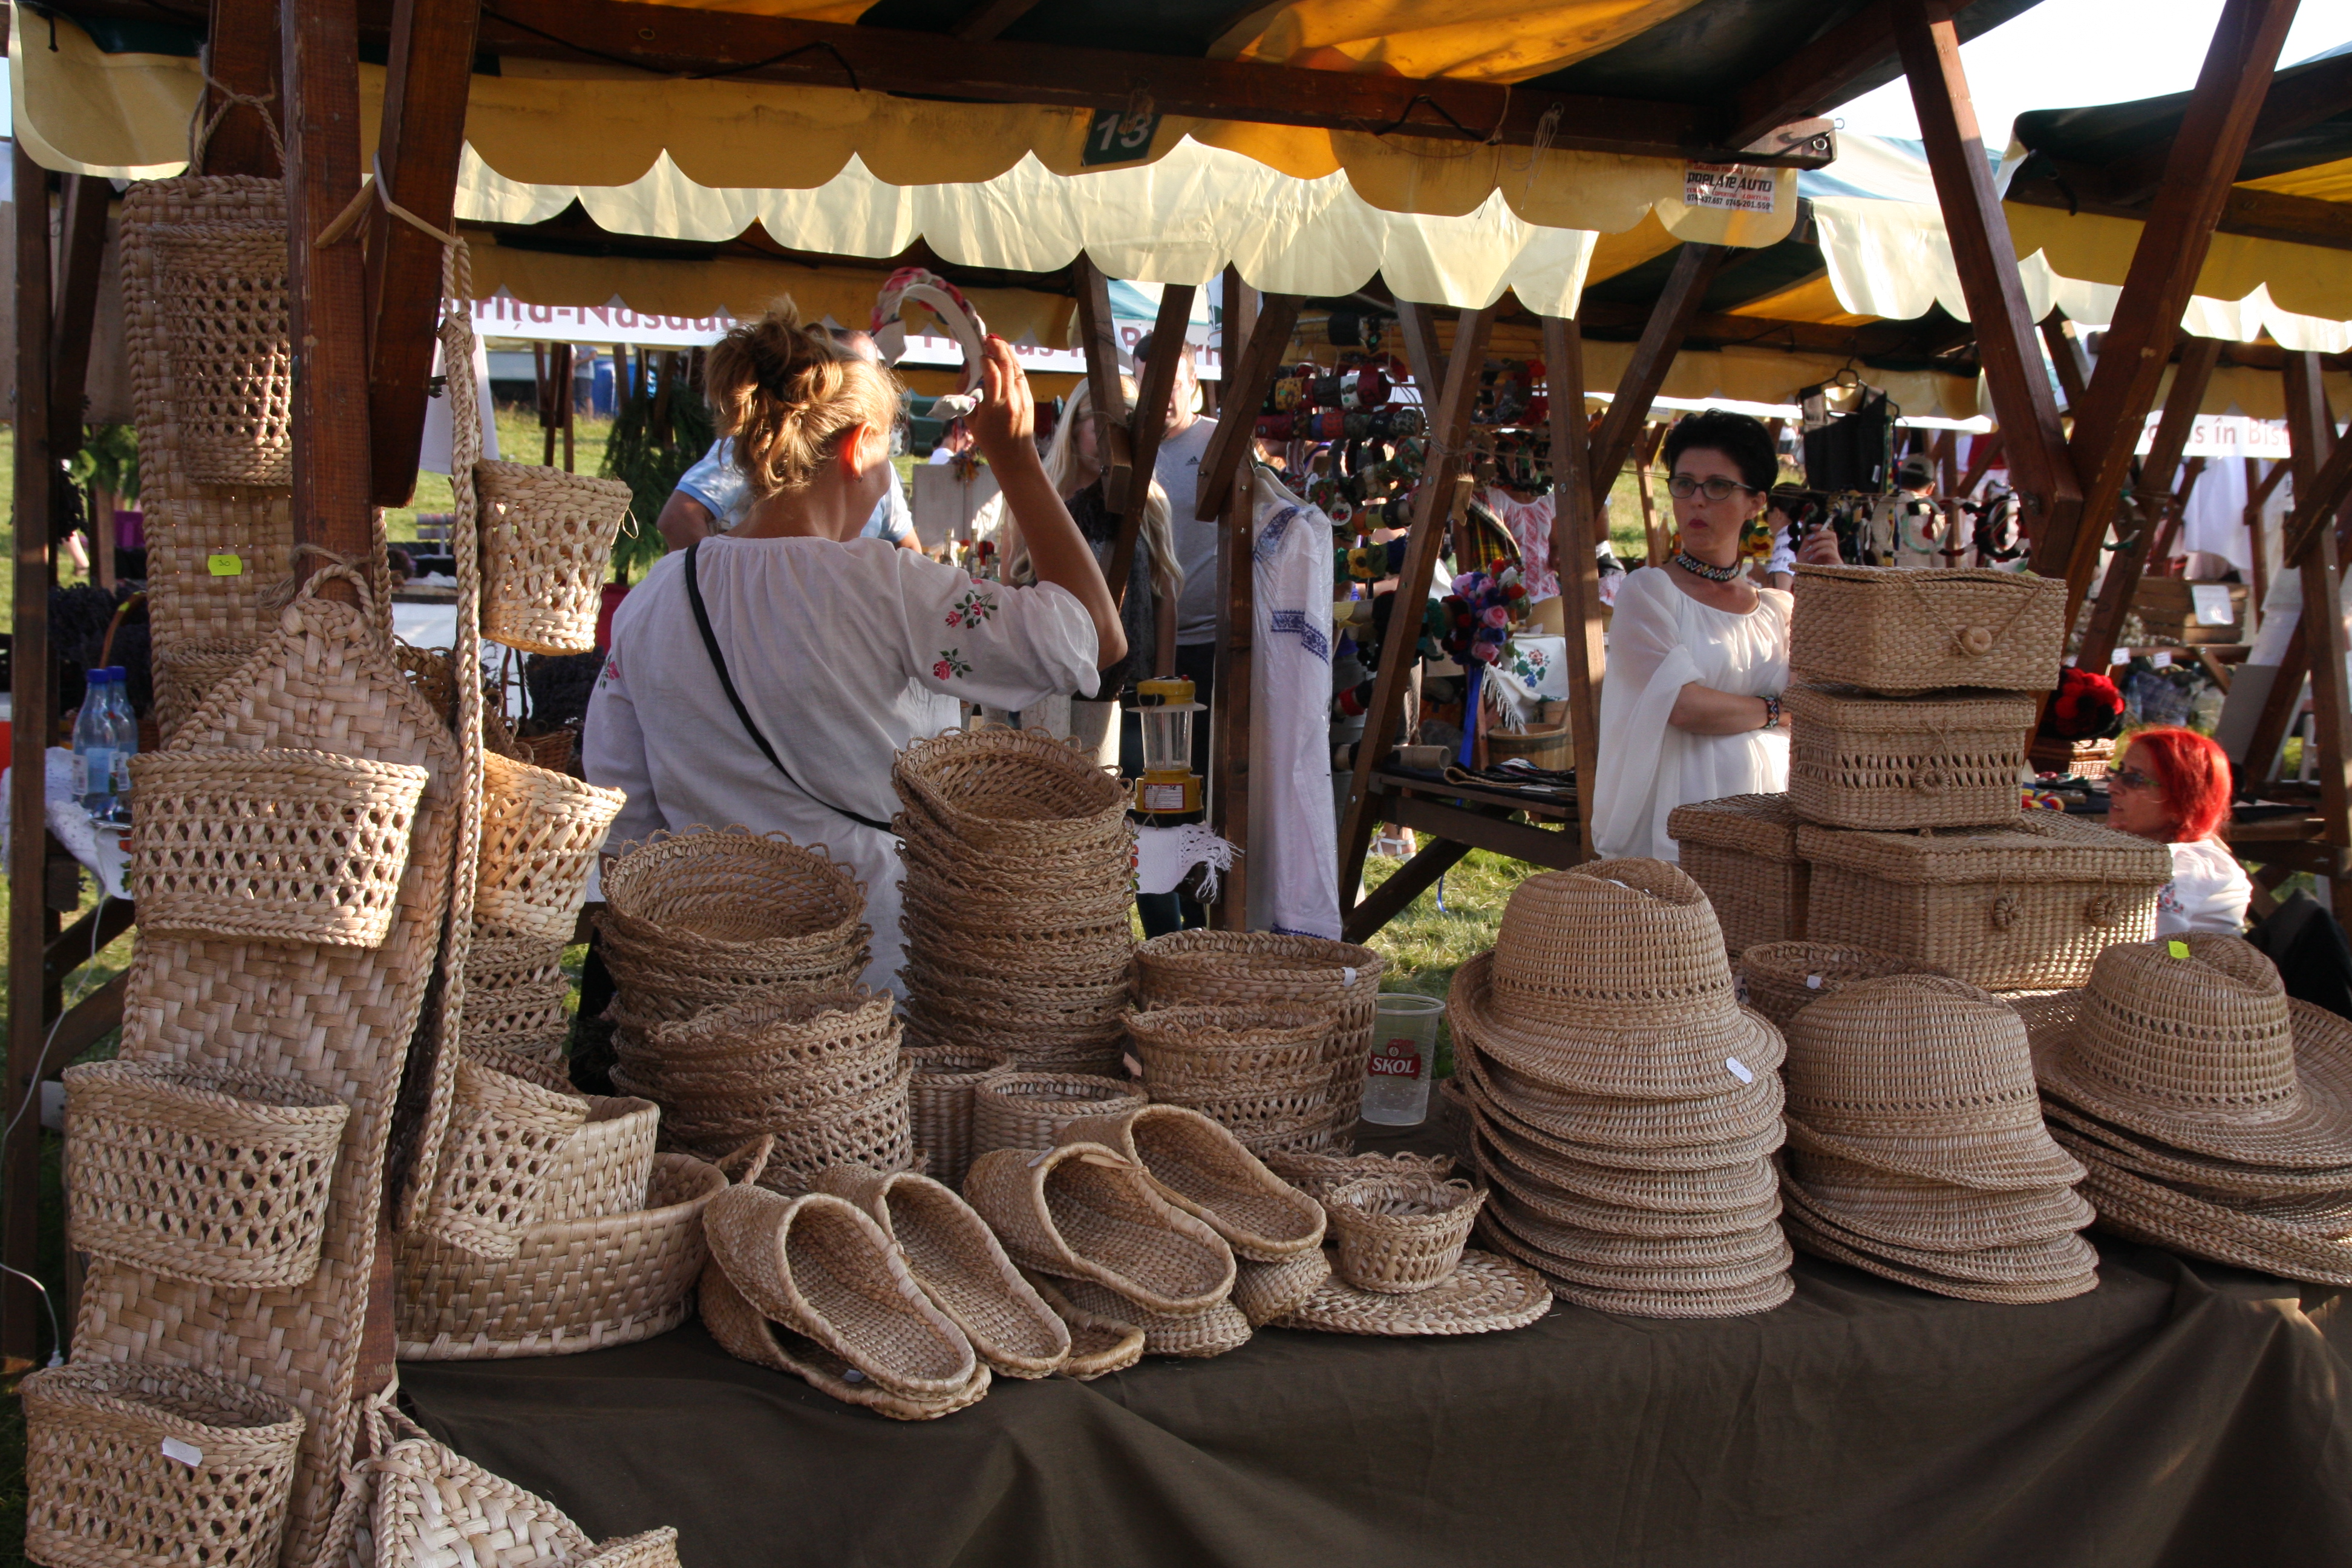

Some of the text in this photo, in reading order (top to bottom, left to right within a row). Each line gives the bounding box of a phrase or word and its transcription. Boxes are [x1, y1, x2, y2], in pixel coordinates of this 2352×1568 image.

[1096, 113, 1154, 151] 13
[1735, 177, 1772, 193] AUTO
[1371, 1057, 1415, 1074] SKOL
